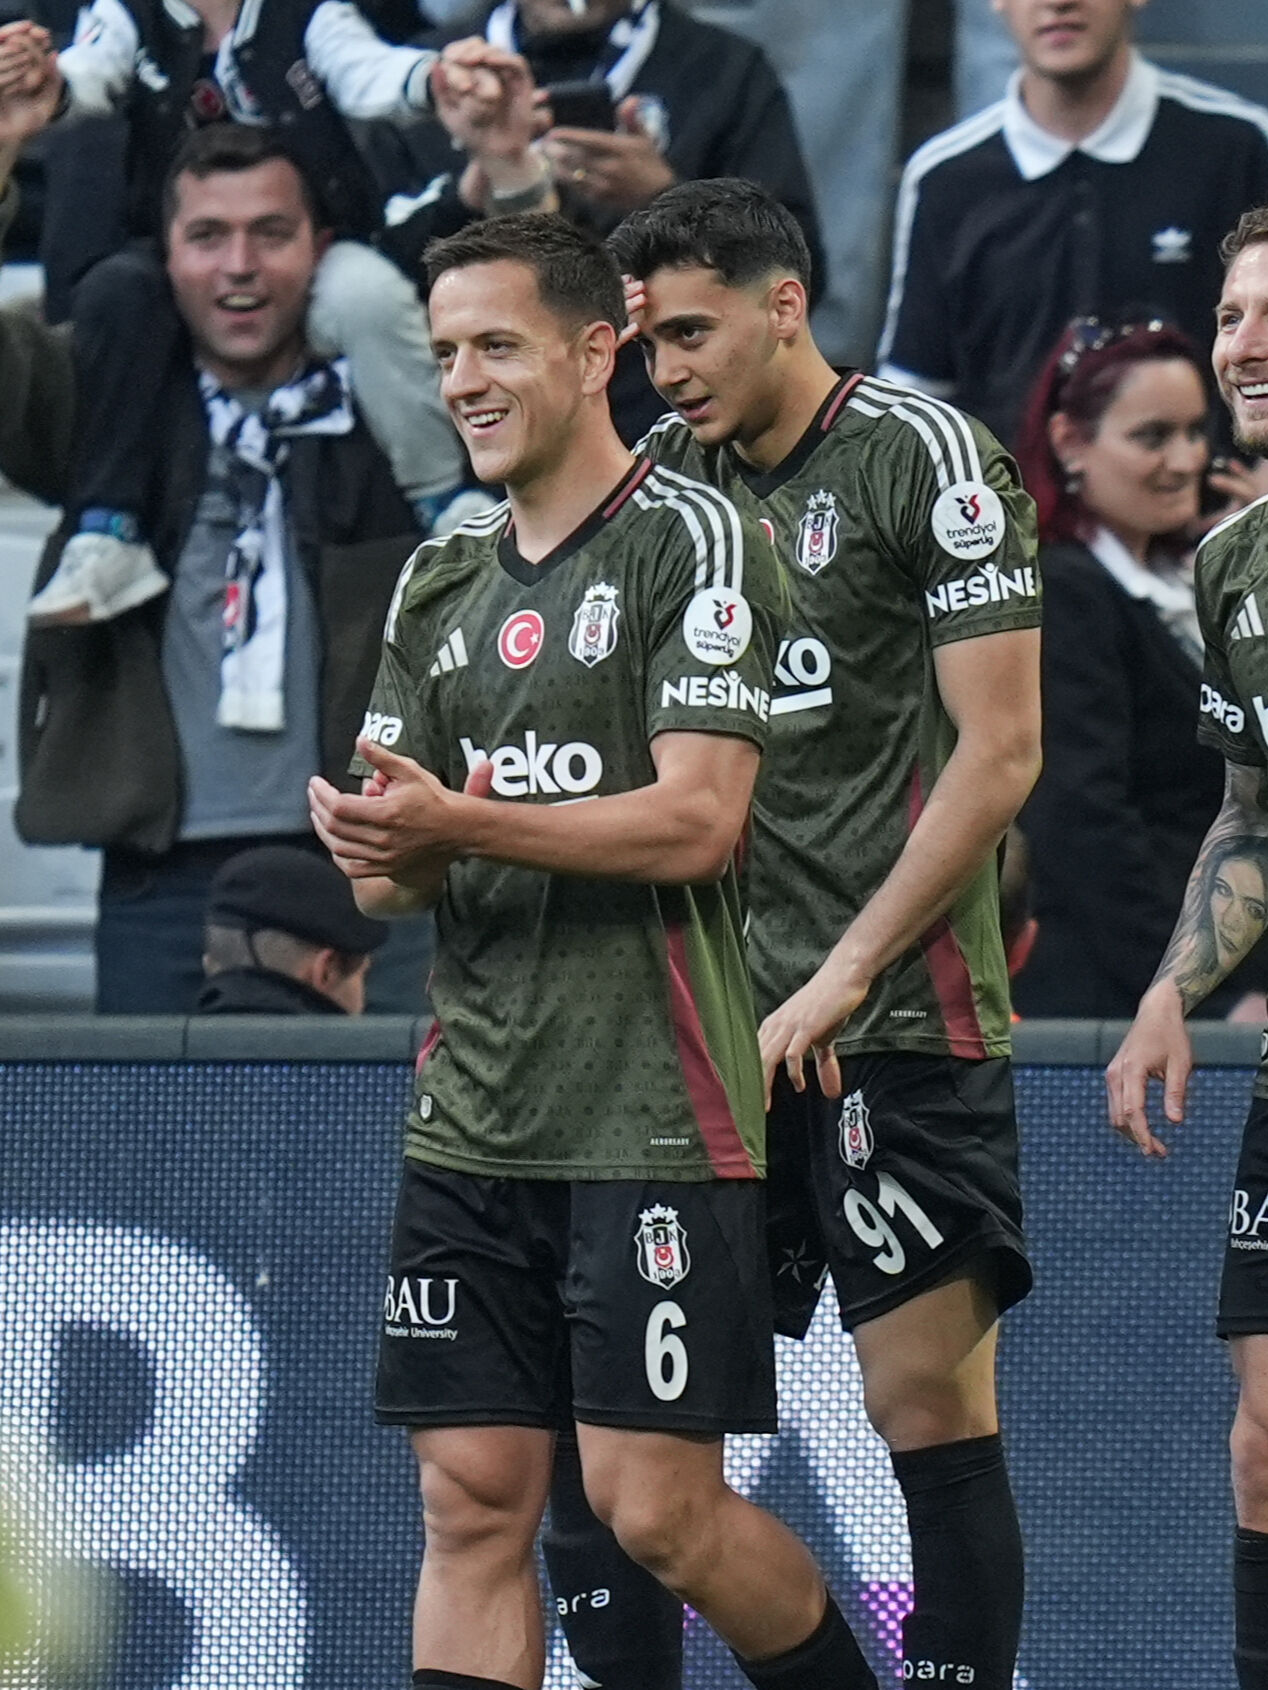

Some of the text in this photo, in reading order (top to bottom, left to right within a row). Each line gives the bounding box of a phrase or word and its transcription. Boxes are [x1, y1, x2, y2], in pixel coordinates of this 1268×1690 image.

[946, 520, 997, 540] trendyol
[843, 1171, 945, 1275] 91
[383, 1275, 460, 1326] BAU
[645, 1300, 689, 1401] 6
